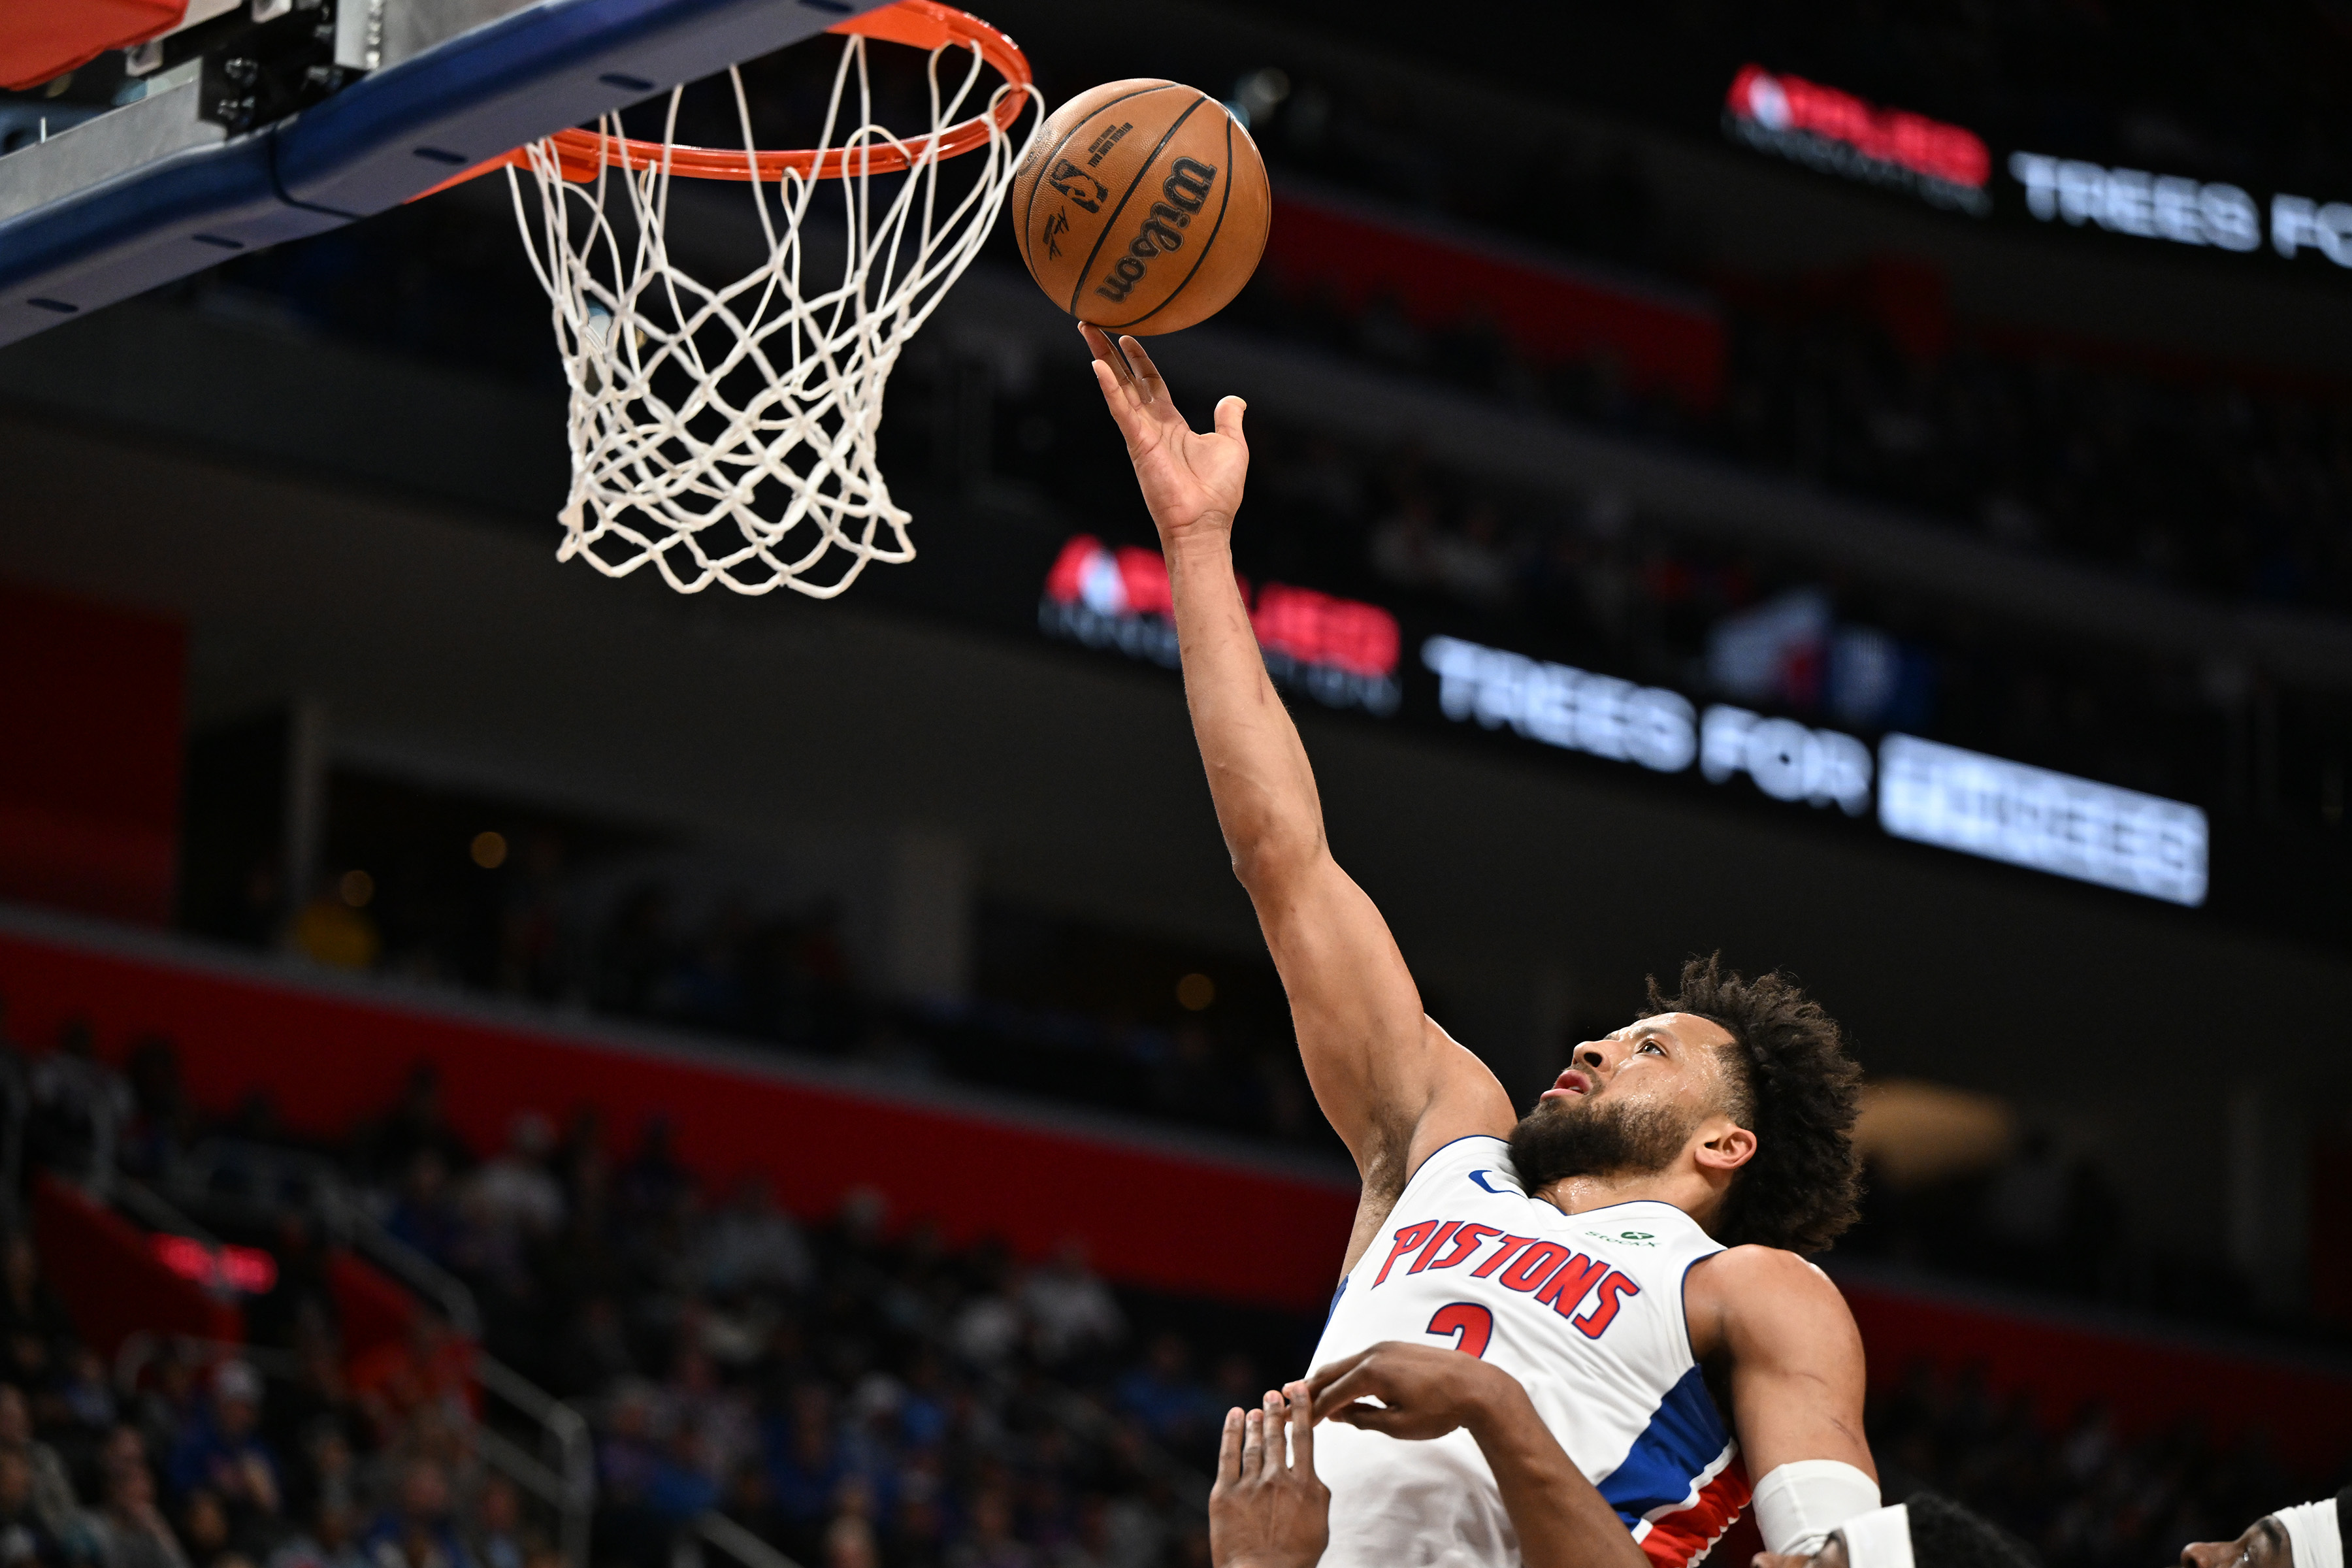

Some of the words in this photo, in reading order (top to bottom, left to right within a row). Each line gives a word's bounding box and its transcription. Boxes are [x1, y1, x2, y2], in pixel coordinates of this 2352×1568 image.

[1094, 156, 1217, 304] Wilson
[2010, 151, 2261, 252] TREES
[1422, 636, 1697, 772] TREES
[1700, 704, 1872, 815] FOR
[1371, 1219, 1641, 1339] PISTONS
